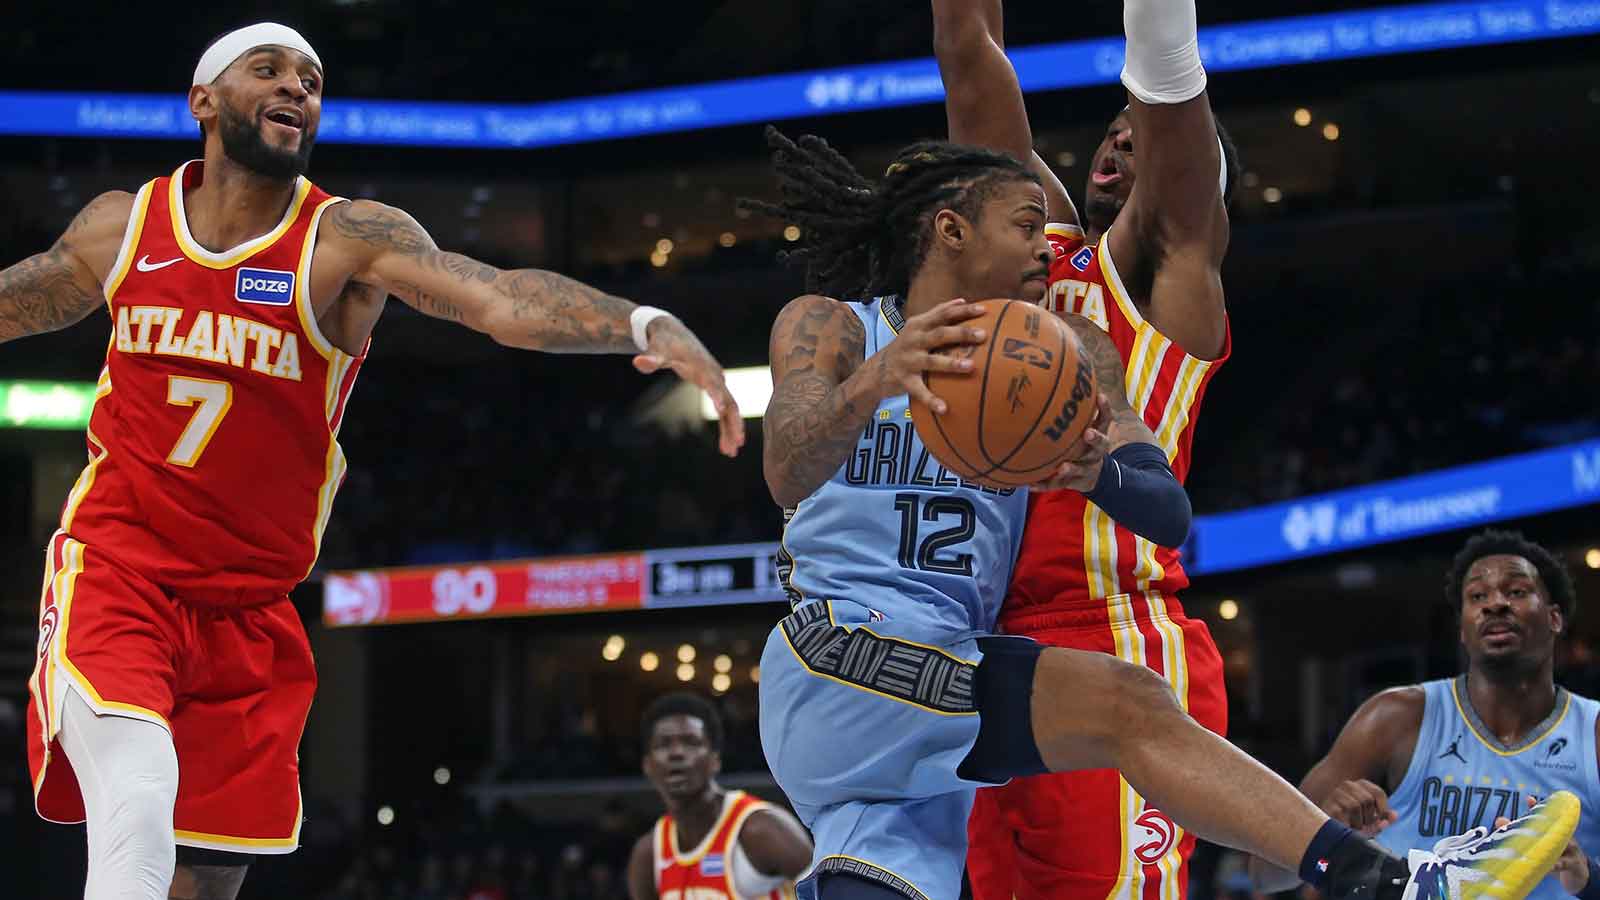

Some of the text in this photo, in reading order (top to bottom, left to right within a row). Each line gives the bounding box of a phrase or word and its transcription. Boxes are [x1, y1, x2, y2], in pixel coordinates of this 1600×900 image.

[240, 275, 289, 294] paze
[116, 305, 303, 382] ATLANTA
[166, 374, 233, 468] 7
[894, 493, 976, 577] 12
[432, 565, 497, 616] 90
